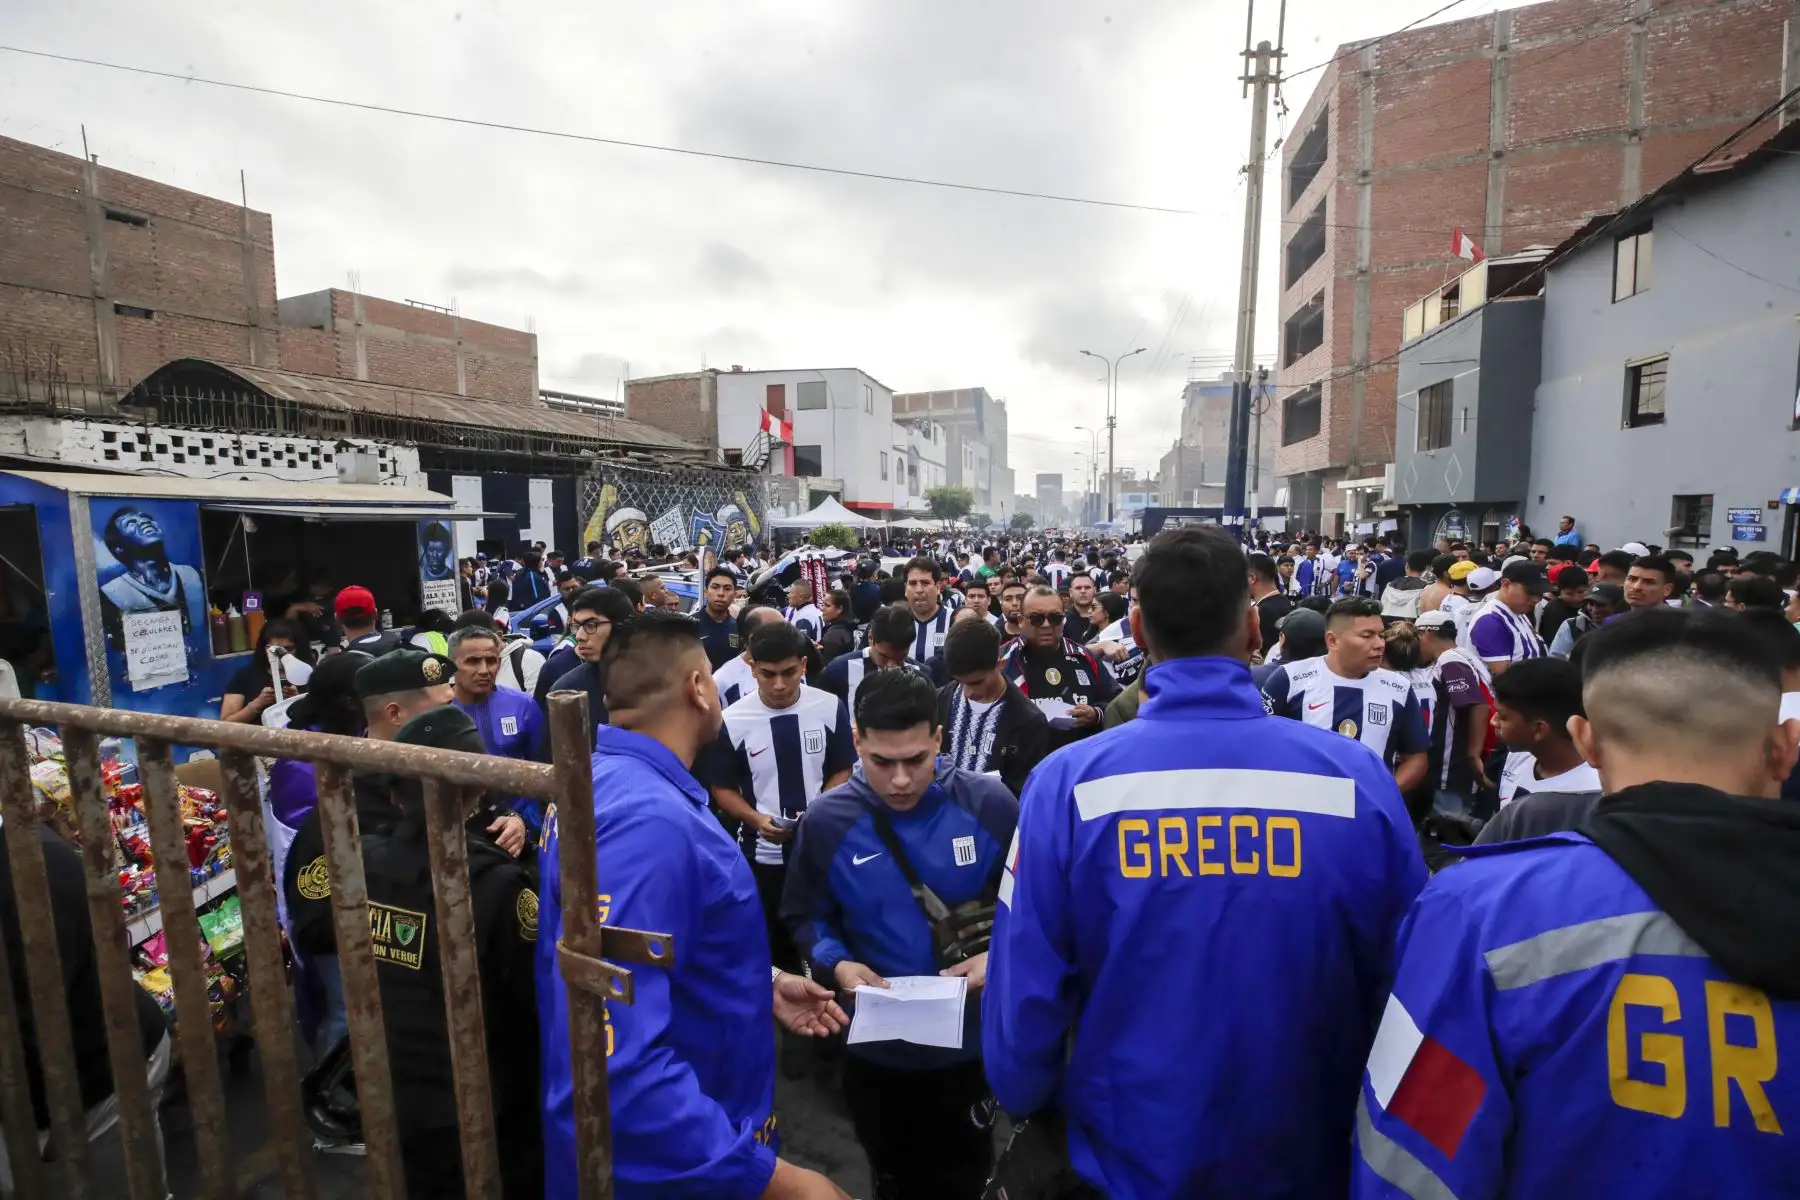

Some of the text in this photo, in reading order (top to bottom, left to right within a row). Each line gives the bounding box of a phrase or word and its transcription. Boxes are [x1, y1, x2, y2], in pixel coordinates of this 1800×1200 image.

[1292, 669, 1319, 682] GLORY
[1118, 815, 1301, 878] GRECO
[390, 947, 418, 964] VERDE
[1607, 974, 1785, 1136] GR
